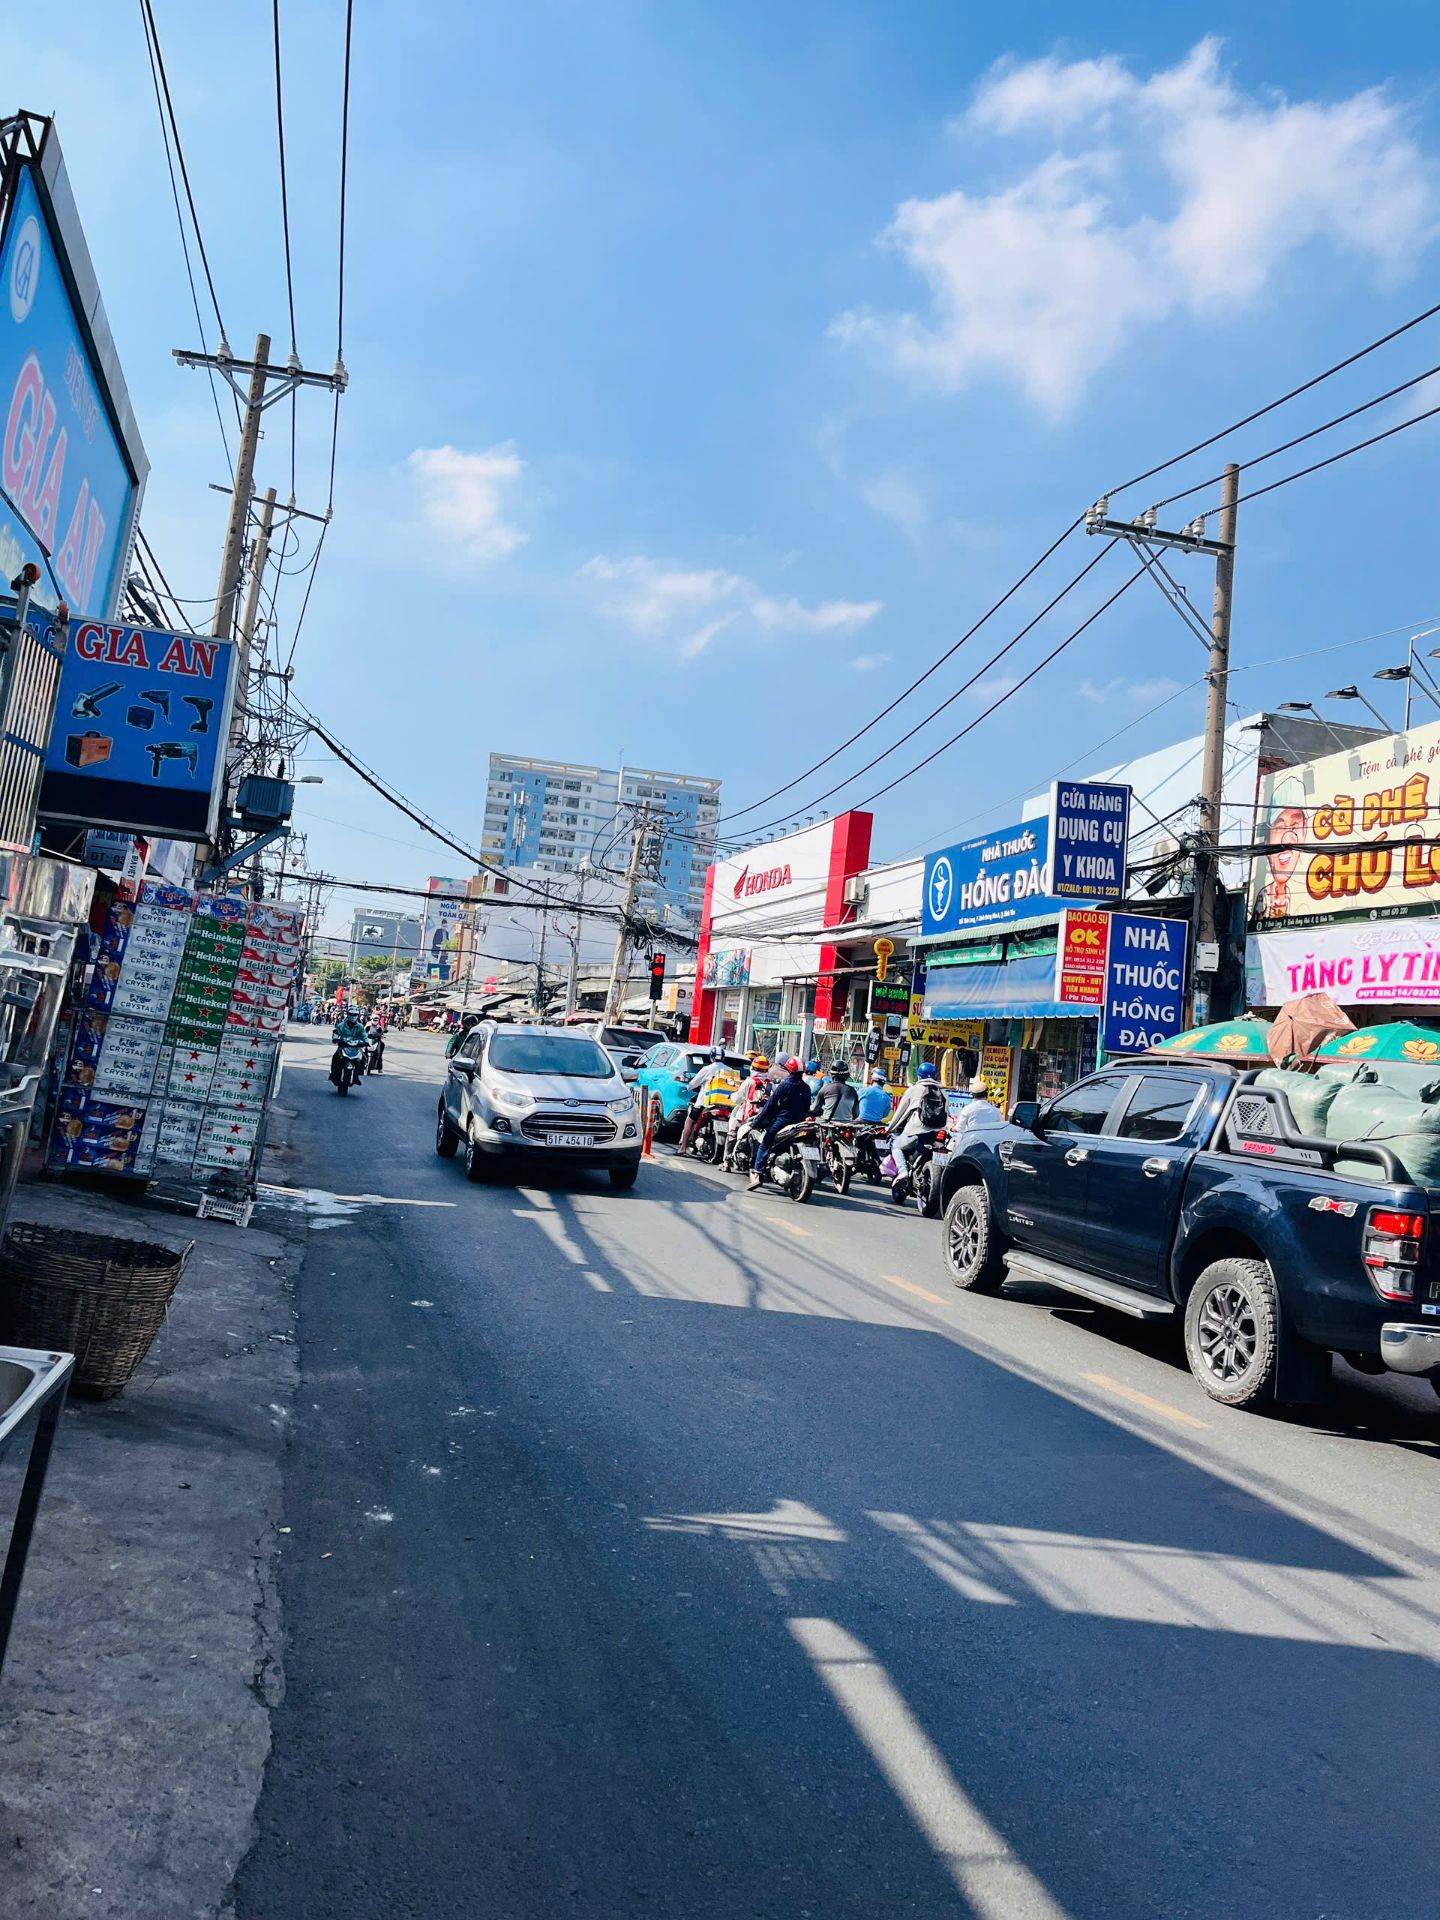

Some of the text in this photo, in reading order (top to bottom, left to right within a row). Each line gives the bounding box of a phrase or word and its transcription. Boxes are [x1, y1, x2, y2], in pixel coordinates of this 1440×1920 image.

[3, 351, 106, 619] GIA AN
[74, 621, 150, 670] GIA
[157, 636, 220, 680] AN
[1403, 745, 1423, 769] phê
[1061, 787, 1122, 812] CỬA HÀNG
[1362, 772, 1429, 832] PHÊ
[1058, 816, 1123, 849] DỤNG CỤ
[982, 841, 1001, 862] NHÀ
[1002, 829, 1037, 857] THUỐC
[1063, 854, 1116, 880] Y KHOA
[1306, 831, 1393, 901] CHÚ
[745, 864, 792, 897] HONDA
[159, 889, 182, 902] Tiger
[961, 868, 1010, 910] HỒNG
[142, 911, 176, 926] CRYSTAL
[1067, 911, 1108, 924] BAO CAO SU
[136, 935, 170, 948] CRYSTAL
[201, 929, 242, 945] Heineken
[1070, 928, 1100, 946] OK
[1124, 923, 1170, 952] NHÀ
[250, 938, 292, 954] Heineken
[131, 957, 165, 970] CRYSTAL
[196, 951, 238, 966] Heineken
[245, 960, 287, 975] Heineken
[1362, 952, 1399, 984] LY
[191, 972, 233, 988] Heineken
[1113, 961, 1180, 991] THUỐC
[125, 979, 159, 991] CRYSTAL
[240, 981, 283, 996] Heineken
[1397, 987, 1440, 997] 14/02/20
[120, 1001, 155, 1013] CRYSTAL
[186, 994, 228, 1009] Heineken
[1112, 995, 1175, 1023] HỒNG
[235, 1003, 278, 1017] Heineken
[115, 1023, 150, 1034] CRYSTAL
[180, 1016, 223, 1031] Heineken
[230, 1024, 273, 1037] Heineken
[110, 1045, 144, 1057] CRYSTAL
[176, 1038, 218, 1051] Heineken
[232, 1047, 273, 1060] Heineken
[104, 1068, 139, 1079] CRYSTAL
[227, 1068, 268, 1081] Heineken
[222, 1090, 263, 1102] Heineken
[157, 1100, 191, 1111] CYSTAL
[217, 1111, 258, 1125] Heineken
[152, 1122, 186, 1133] CYSTAL
[211, 1133, 252, 1147] Heineken
[146, 1144, 180, 1155] CYSTAL
